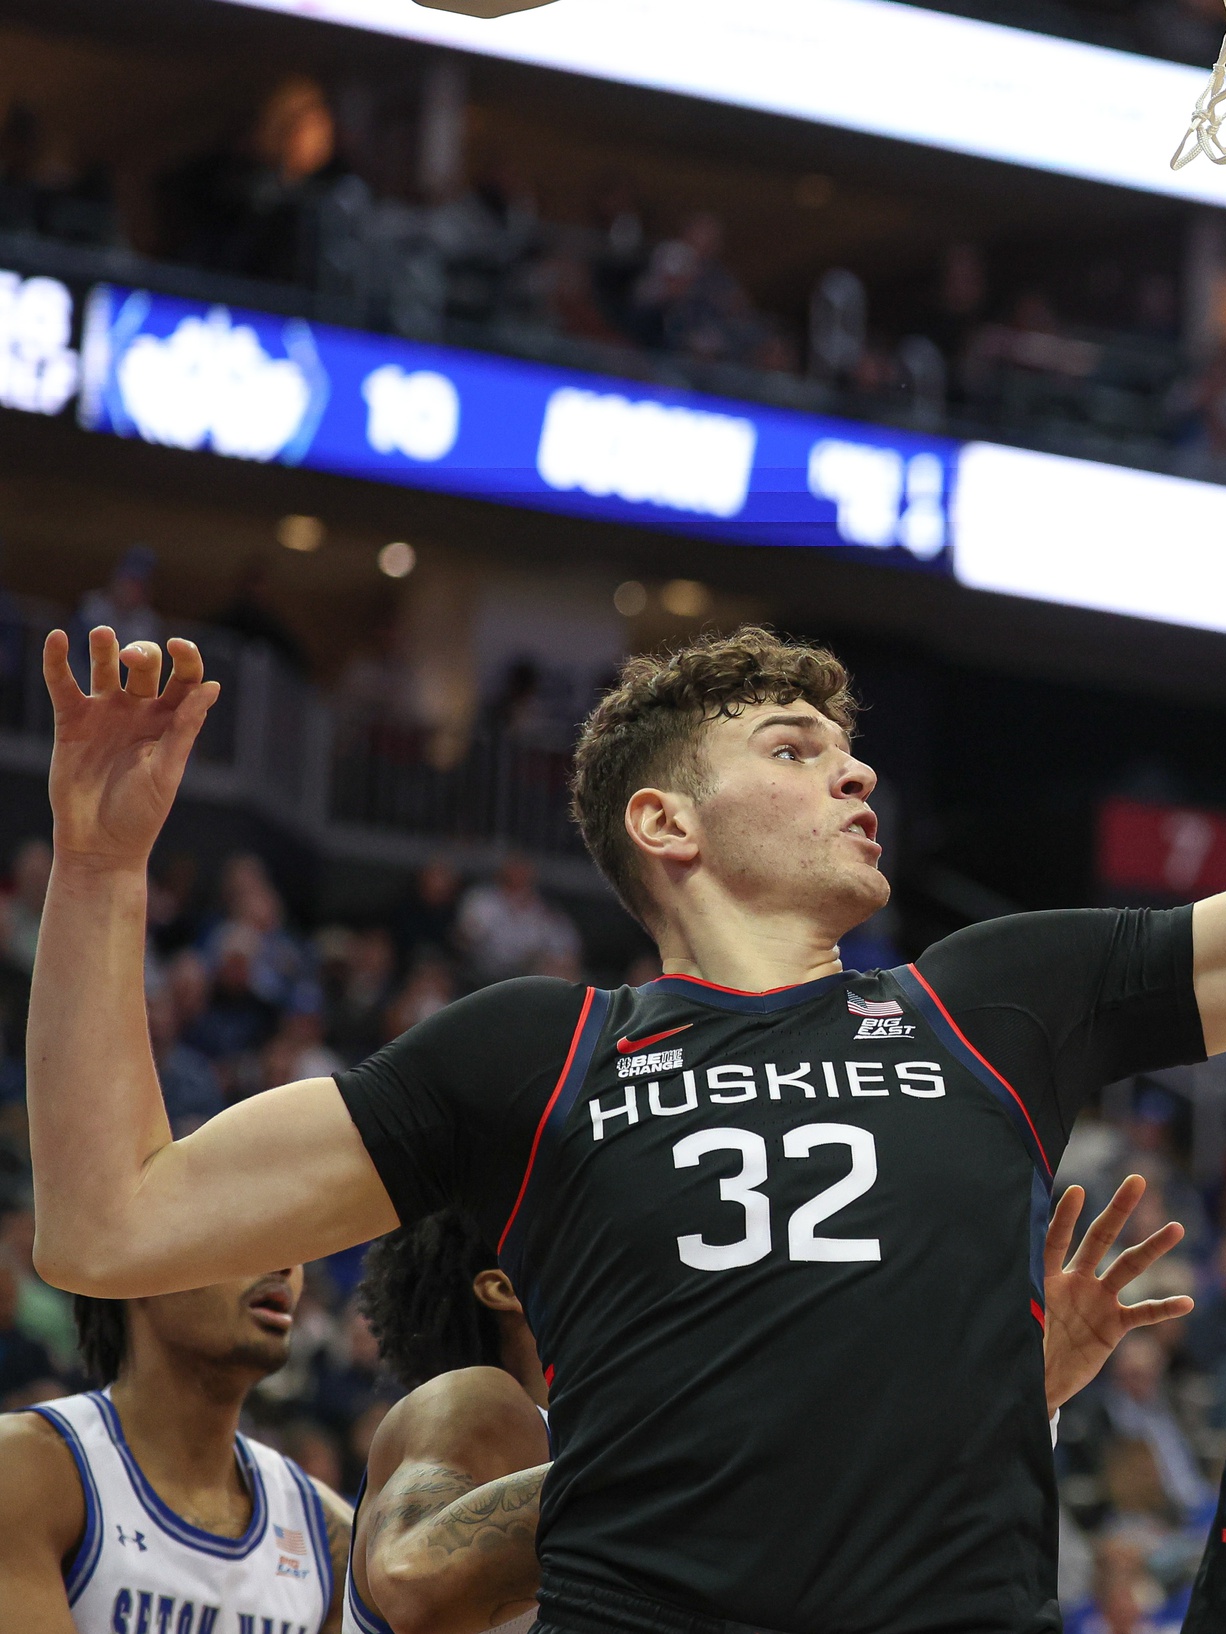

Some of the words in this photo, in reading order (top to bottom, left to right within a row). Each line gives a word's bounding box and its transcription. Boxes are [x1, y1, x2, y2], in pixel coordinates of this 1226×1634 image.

[857, 1025, 916, 1036] EAST
[861, 1017, 902, 1028] BIG
[618, 1059, 684, 1078] CHANGE
[589, 1061, 947, 1141] HUSKIES
[672, 1123, 882, 1272] 32
